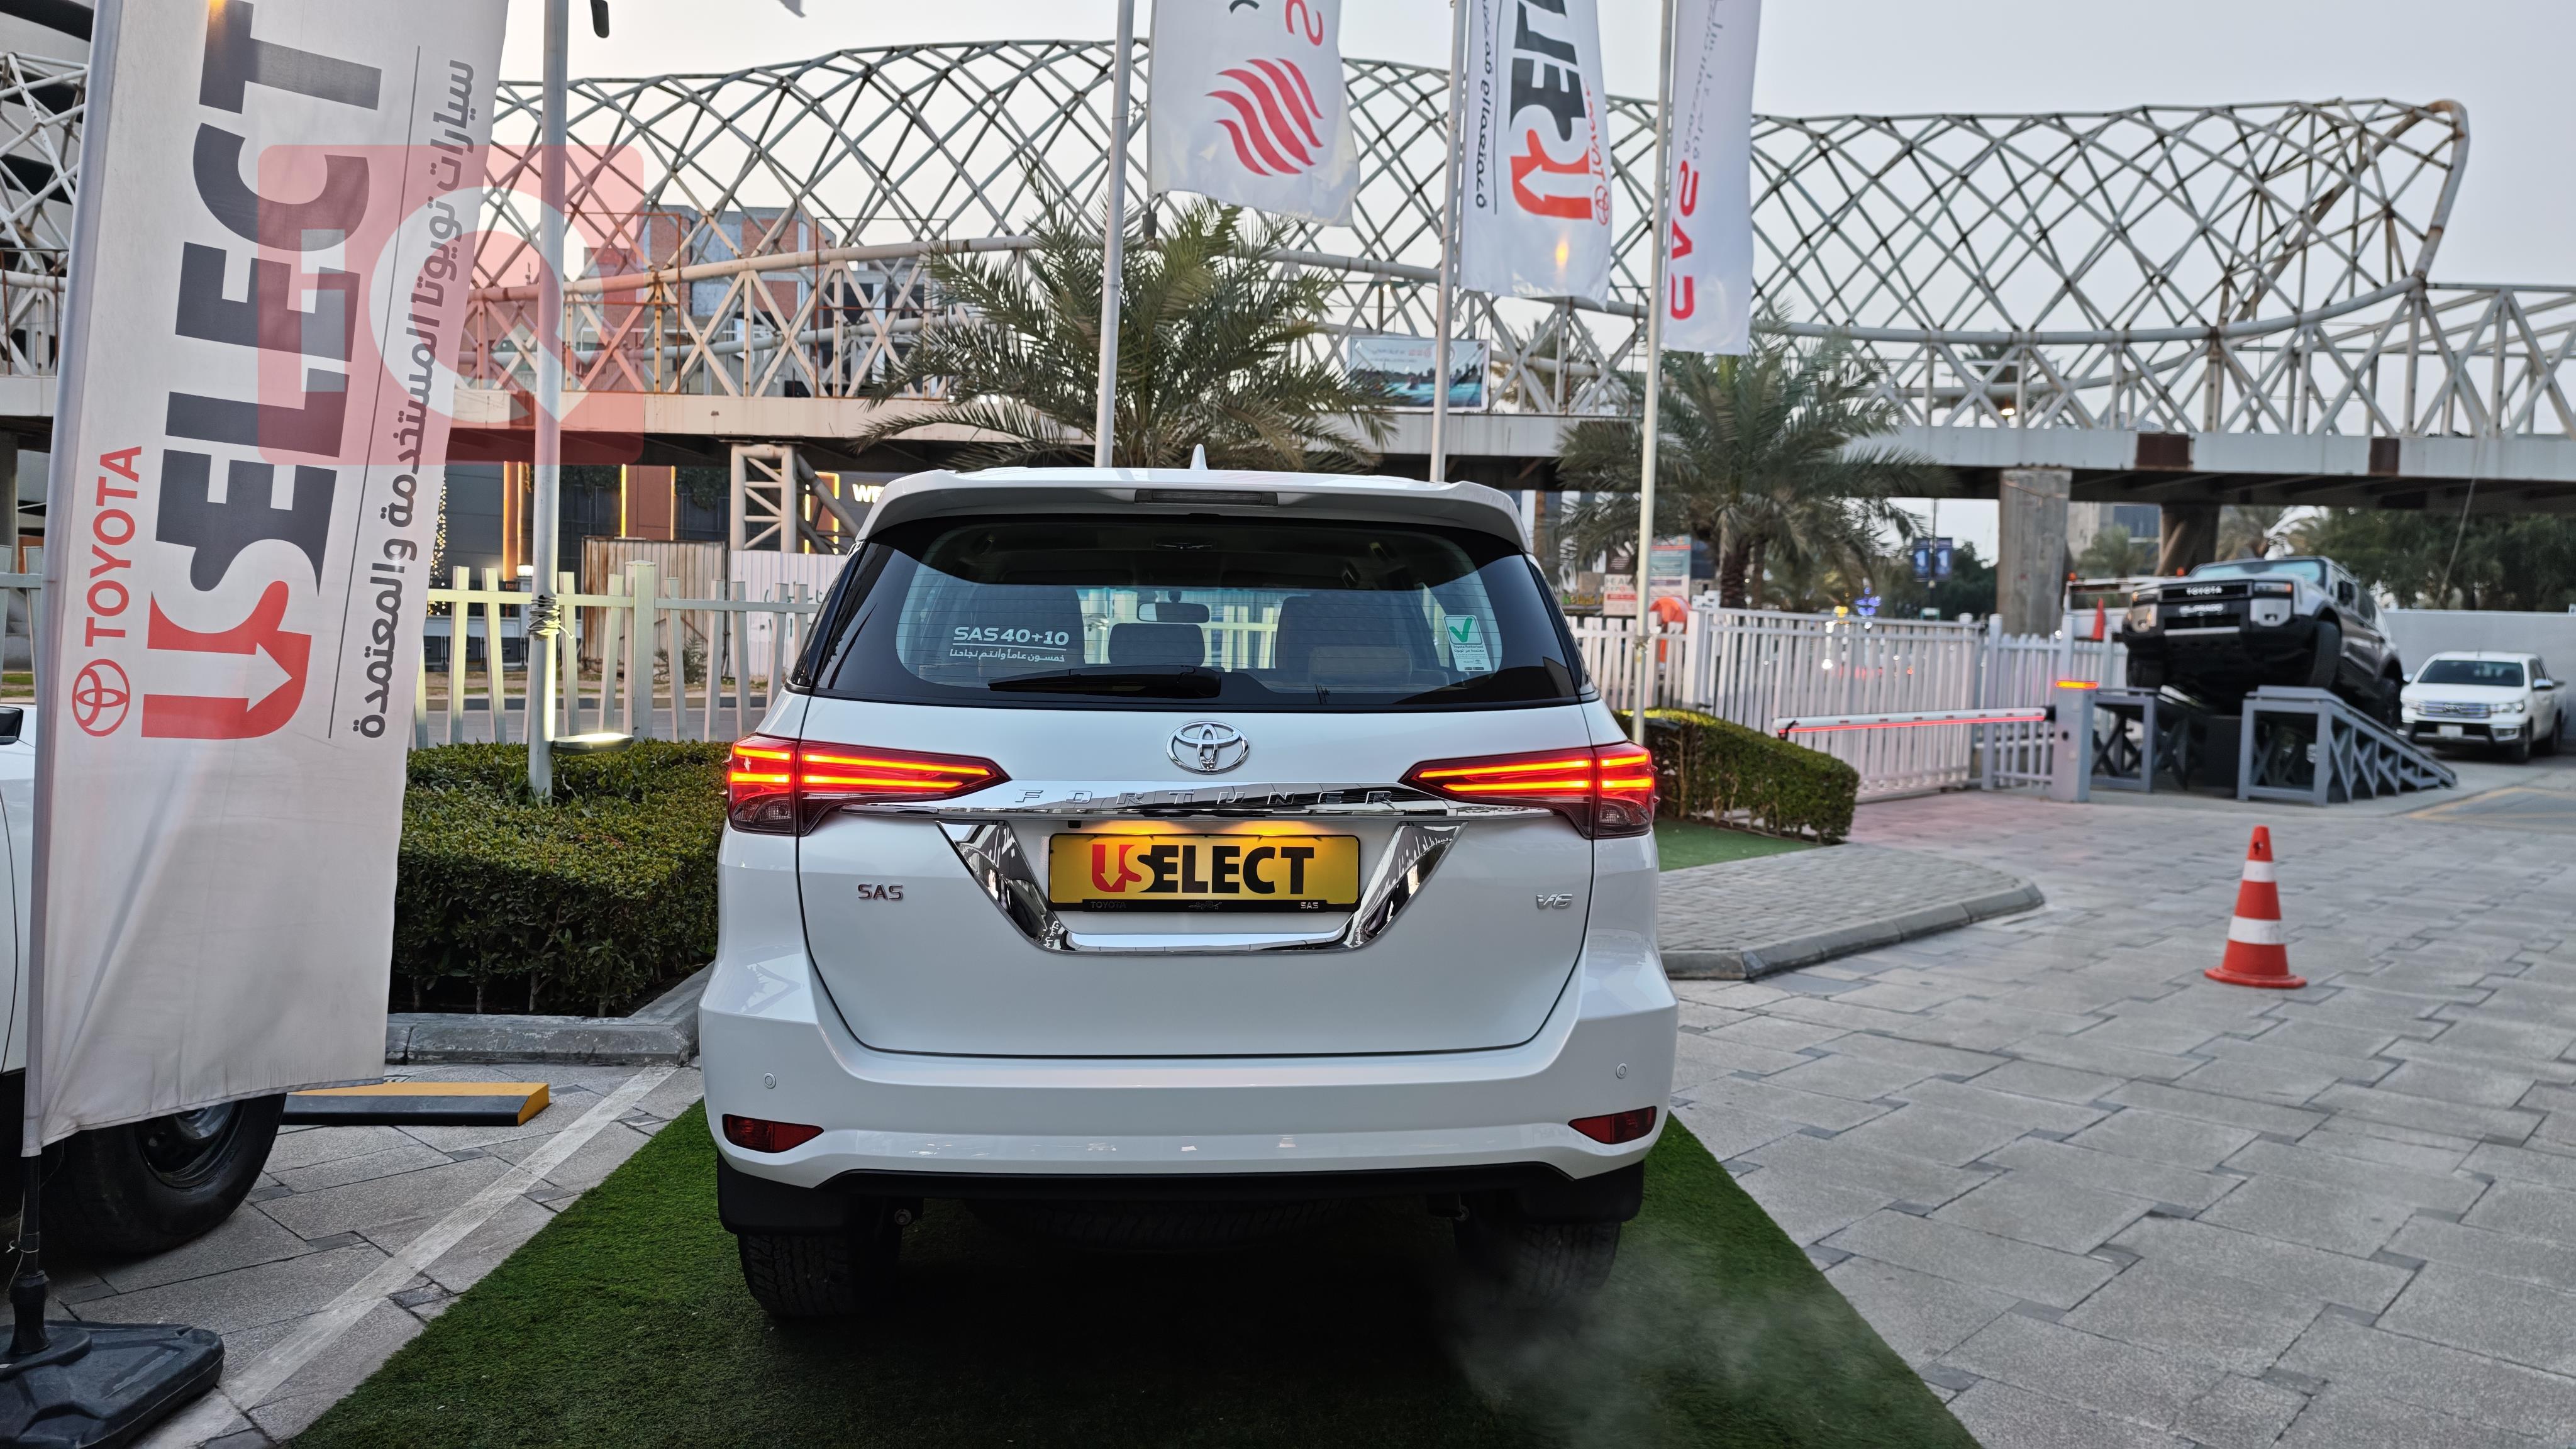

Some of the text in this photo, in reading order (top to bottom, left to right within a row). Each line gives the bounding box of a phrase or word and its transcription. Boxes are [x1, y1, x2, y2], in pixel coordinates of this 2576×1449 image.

[140, 0, 382, 740] USELECT
[352, 60, 477, 738] سيارات تويوتا المستخدمة والمعتمدة
[85, 446, 142, 647] TOYOTA
[953, 626, 1070, 647] SAS 40+10
[1014, 789, 1393, 806] FORTUNER
[1091, 844, 1314, 895] USELECT
[857, 884, 904, 901] SAS
[1536, 893, 1573, 910] V6
[1300, 901, 1319, 909] SAS
